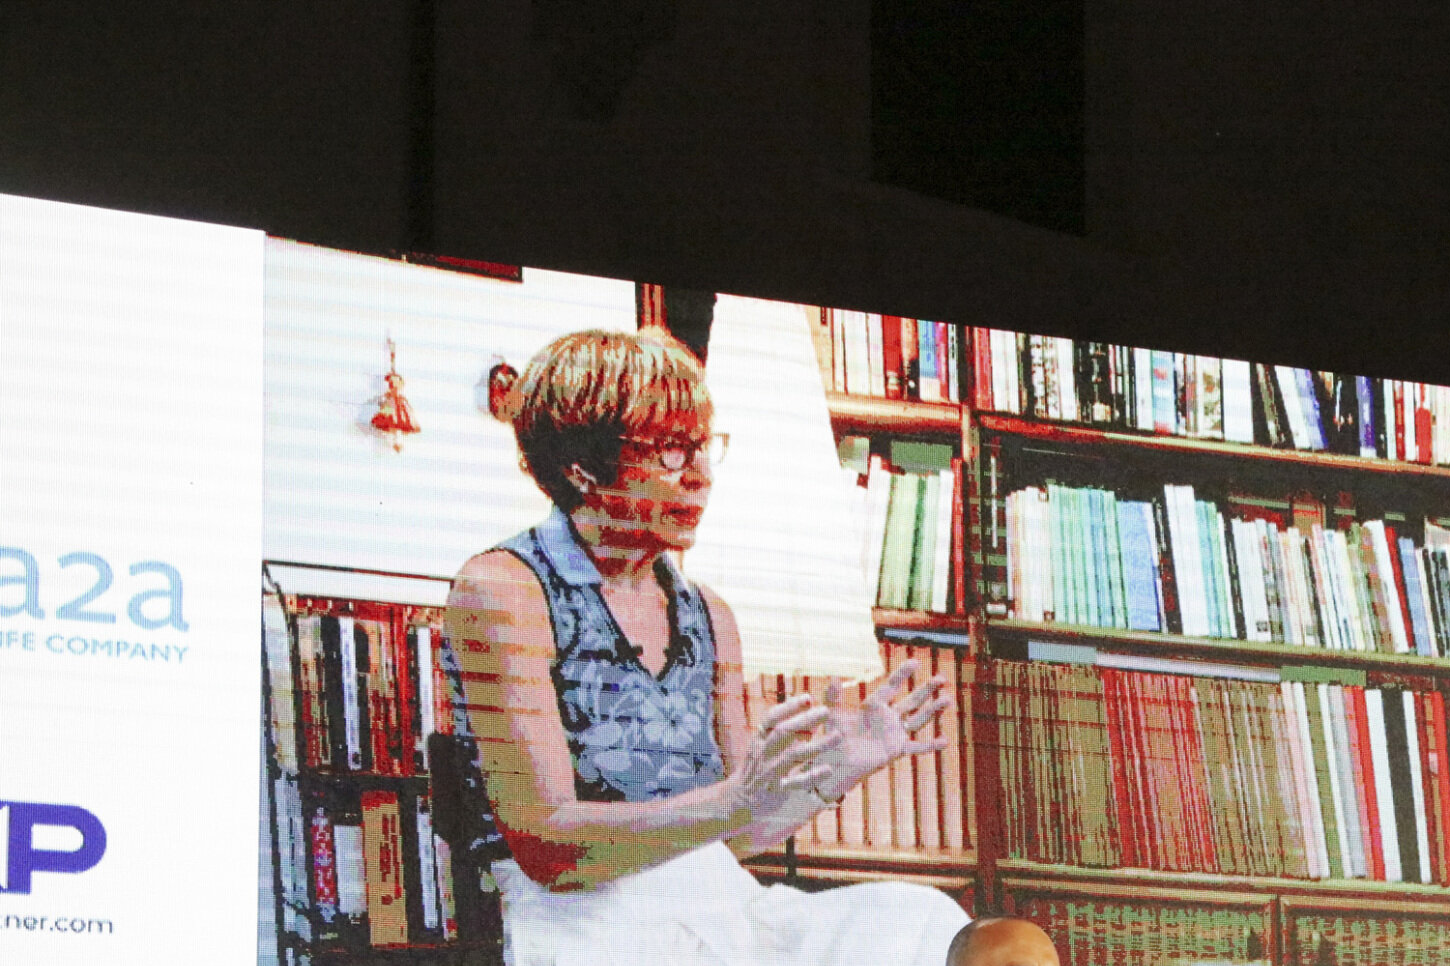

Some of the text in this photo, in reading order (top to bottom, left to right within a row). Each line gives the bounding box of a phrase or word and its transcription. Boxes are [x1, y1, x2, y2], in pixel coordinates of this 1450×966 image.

[0, 631, 189, 664] IFE COMPANY
[0, 801, 108, 895] P
[0, 914, 114, 934] ner.com
